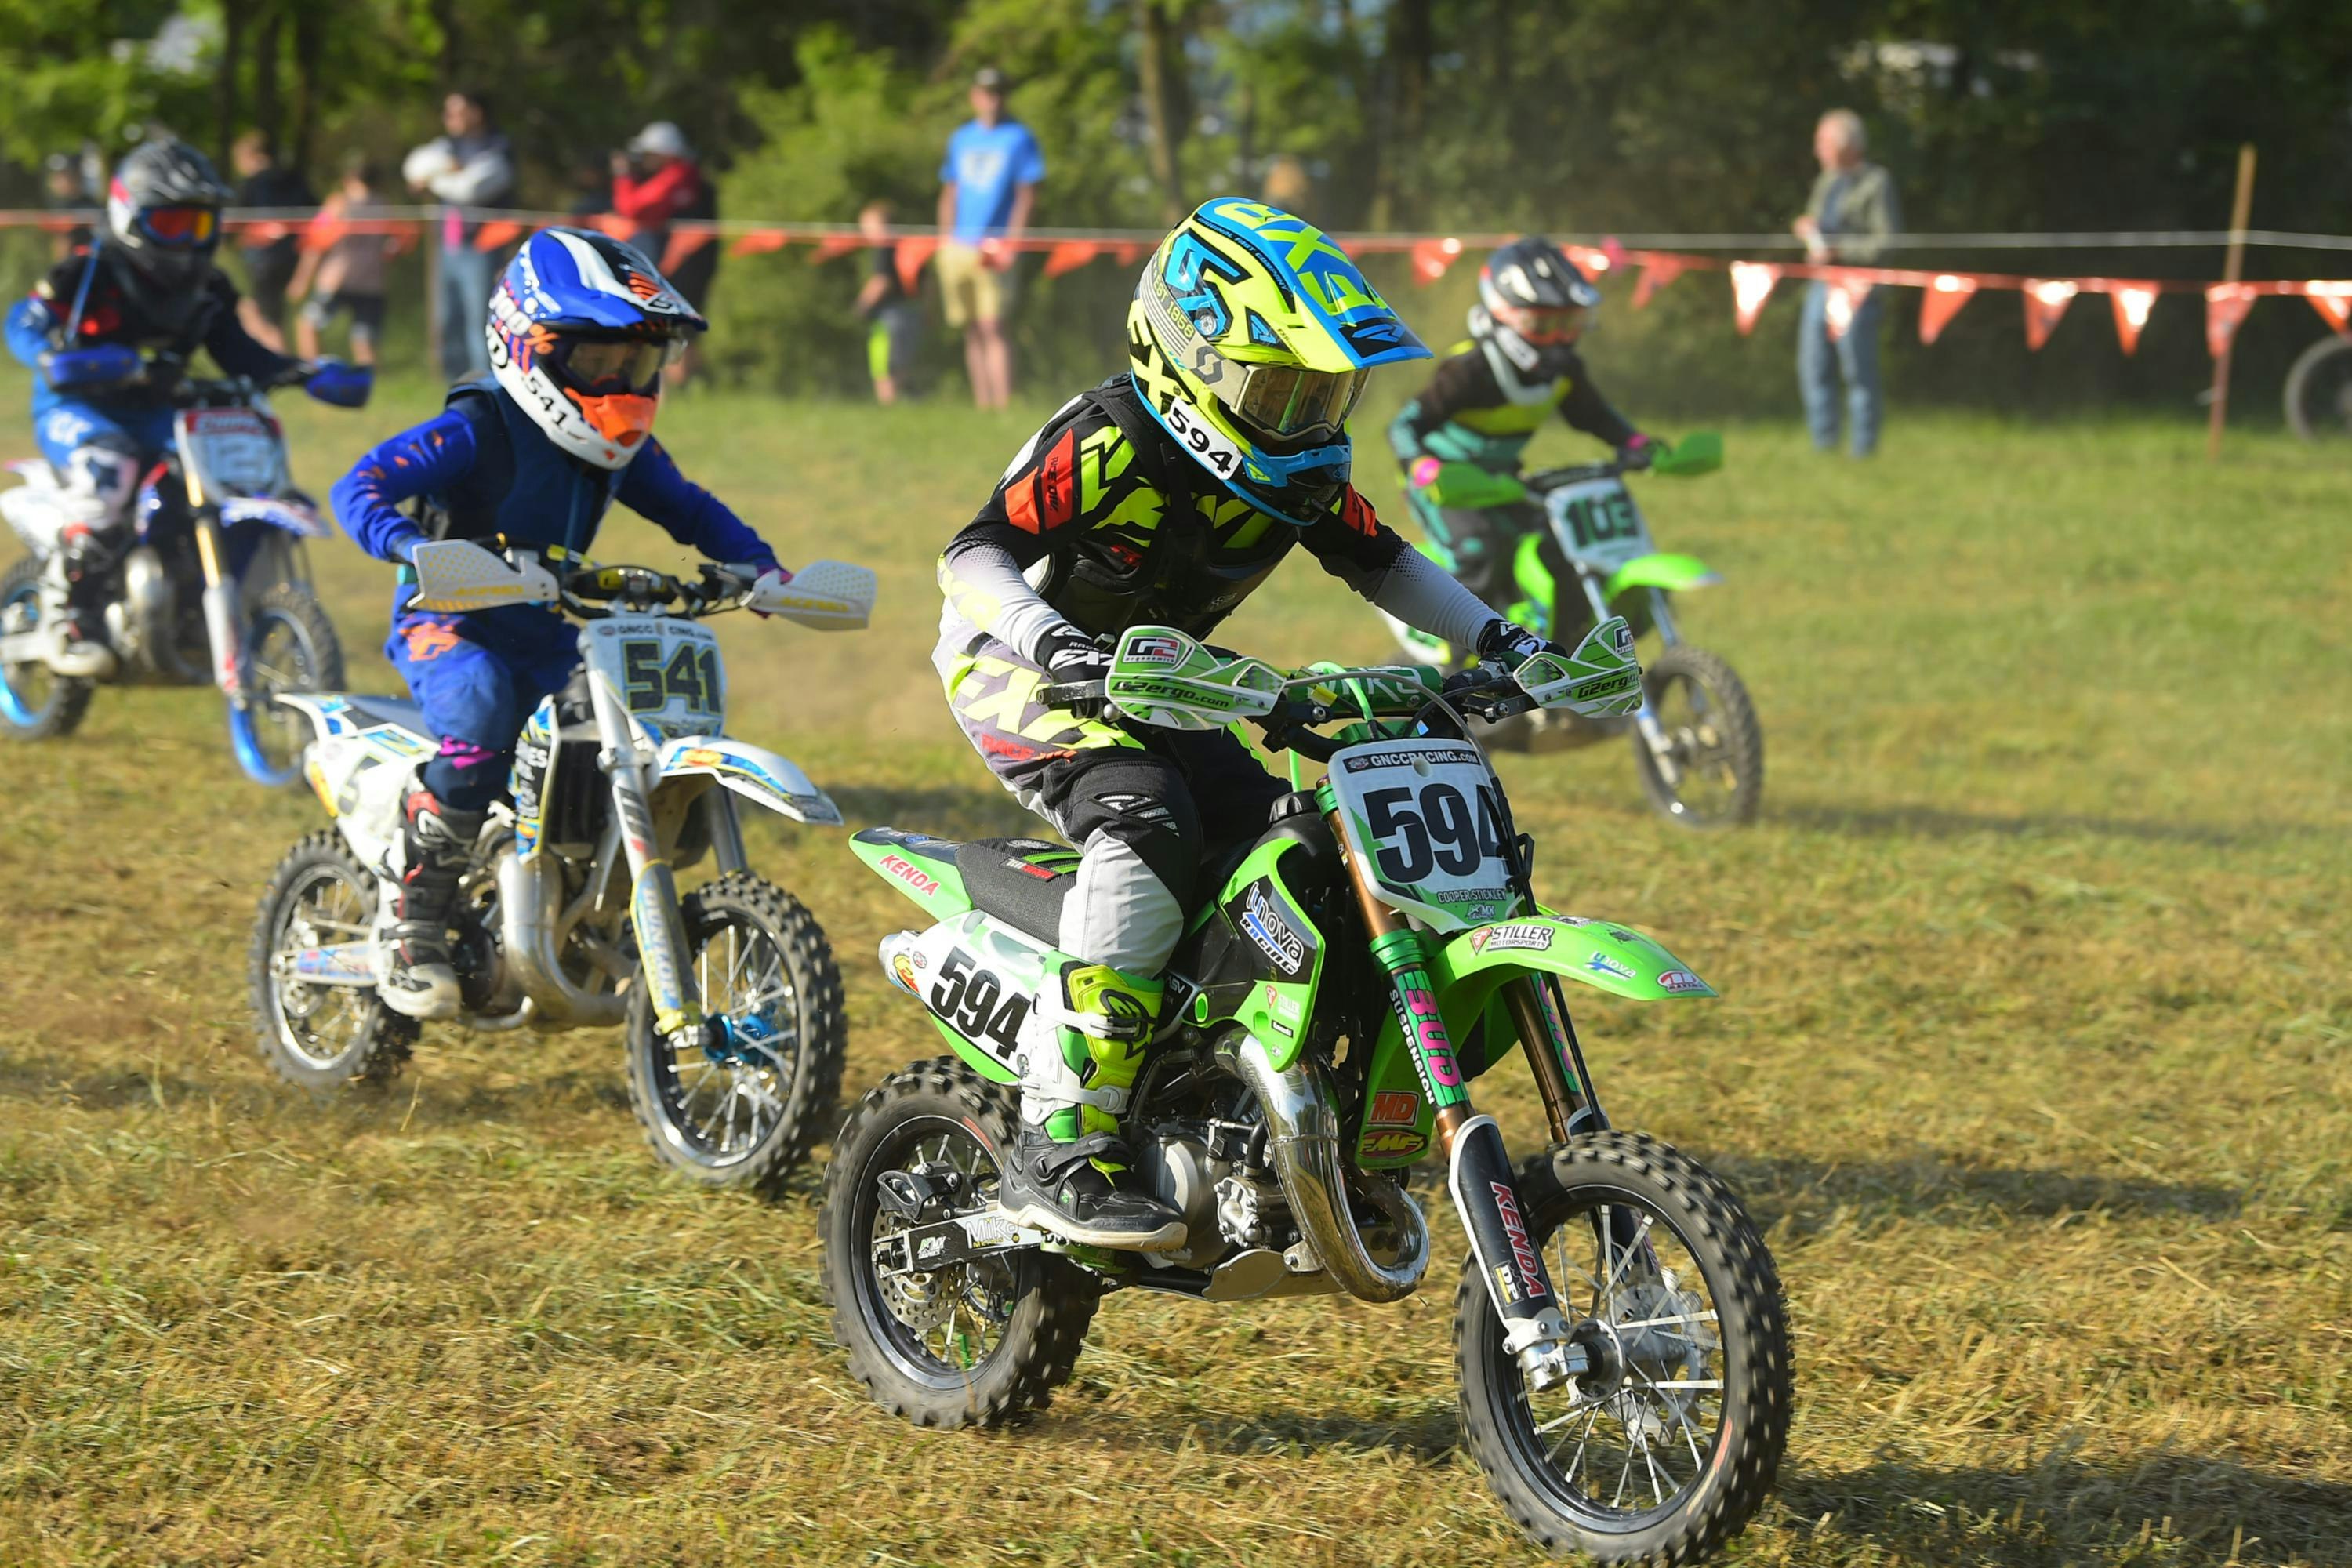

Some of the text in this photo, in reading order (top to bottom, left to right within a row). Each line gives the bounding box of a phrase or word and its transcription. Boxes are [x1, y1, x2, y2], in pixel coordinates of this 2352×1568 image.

[1166, 302, 1196, 339] 1858
[524, 376, 569, 430] 541
[1168, 407, 1233, 473] 594
[624, 642, 723, 715] 541
[1112, 681, 1229, 708] G2ergo.com
[1363, 783, 1508, 884] 594
[879, 855, 940, 895] KENDA
[1437, 888, 1507, 903] COOPER STICKLEY
[1490, 939, 1547, 948] MOTORSPORTS
[1491, 926, 1552, 941] STILLER
[931, 946, 1032, 1061] 594
[1389, 989, 1435, 1105] SUSPENSION
[1361, 1134, 1425, 1152] FMF
[1490, 1181, 1548, 1298] KENDA
